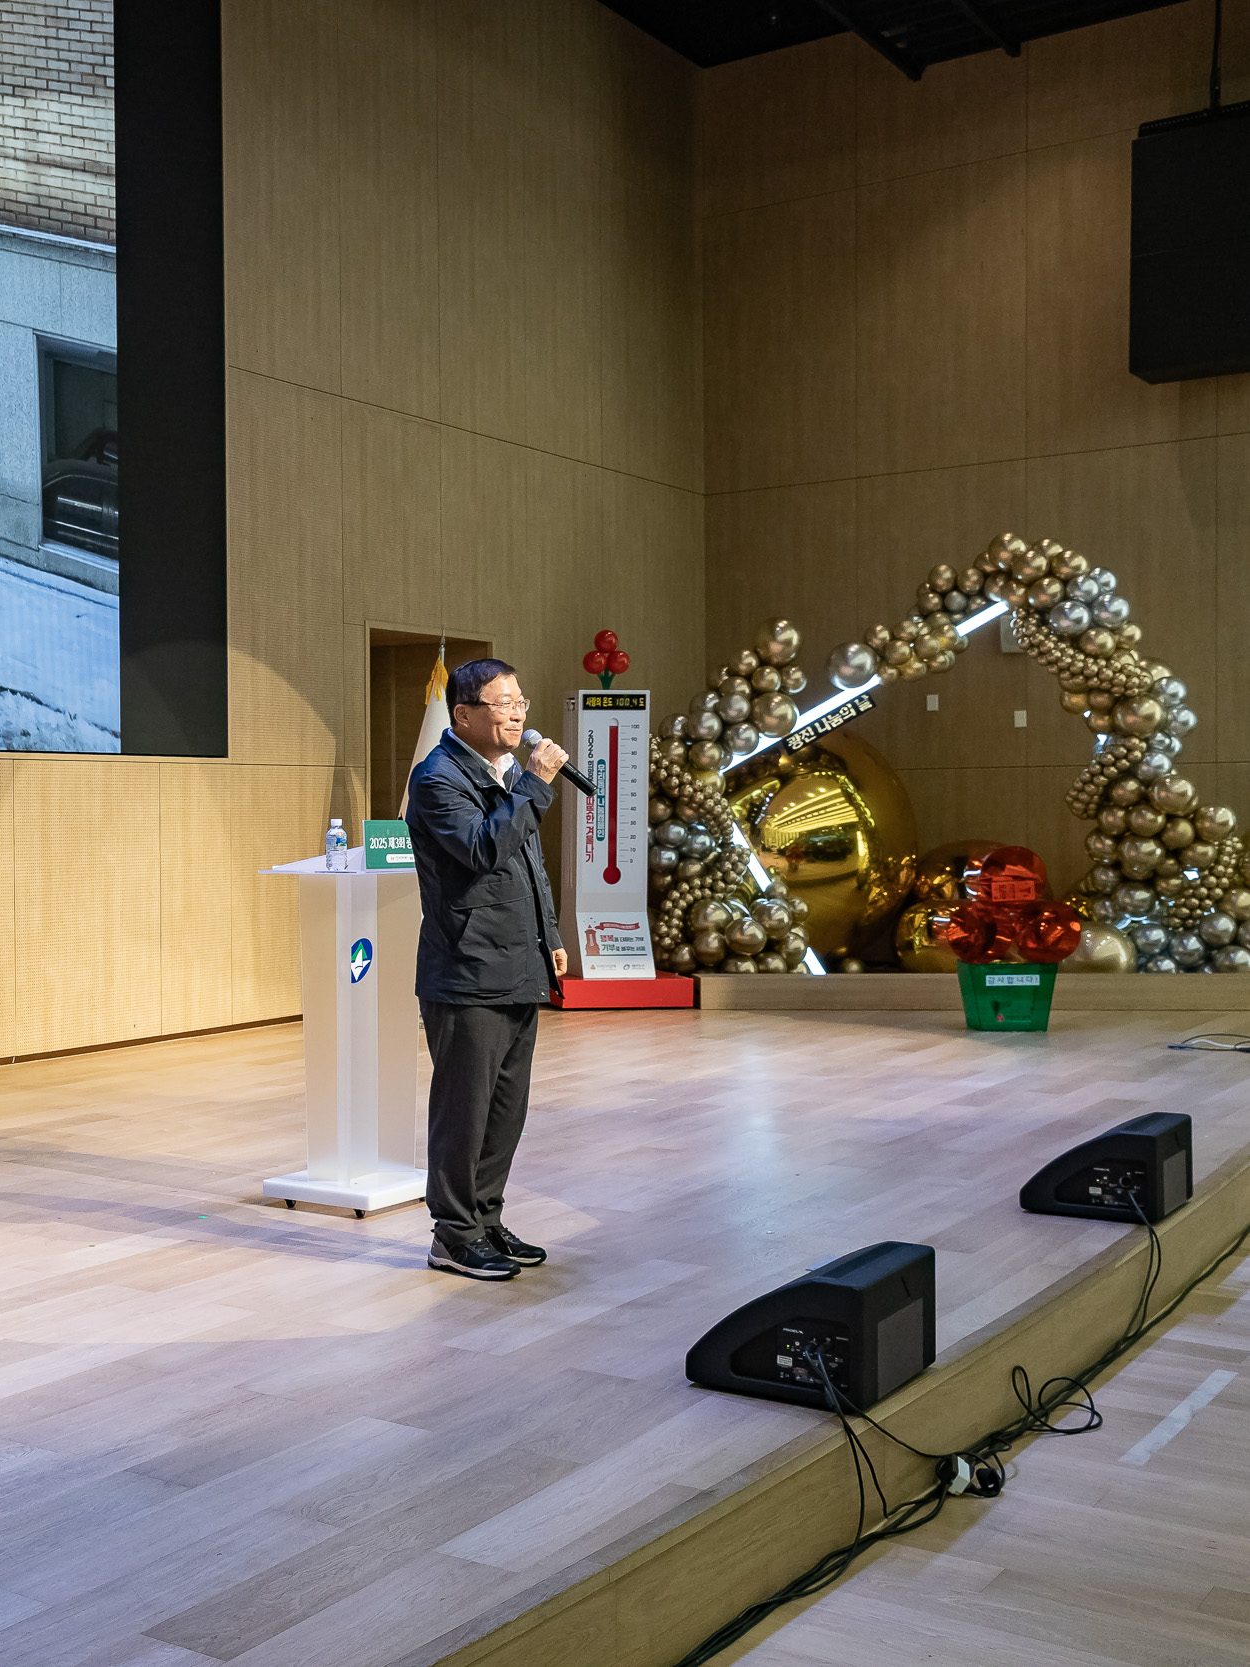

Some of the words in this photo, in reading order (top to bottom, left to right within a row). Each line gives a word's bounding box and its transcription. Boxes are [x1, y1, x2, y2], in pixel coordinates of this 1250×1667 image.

[586, 697, 601, 707] 사랑의
[602, 697, 613, 707] 온도
[638, 697, 645, 707] 도
[786, 726, 817, 750] 광진
[814, 703, 857, 733] 나눔의
[854, 694, 873, 712] 날
[369, 837, 388, 849] 2025
[388, 836, 406, 849] 제3회
[585, 826, 594, 863] 겨울나기
